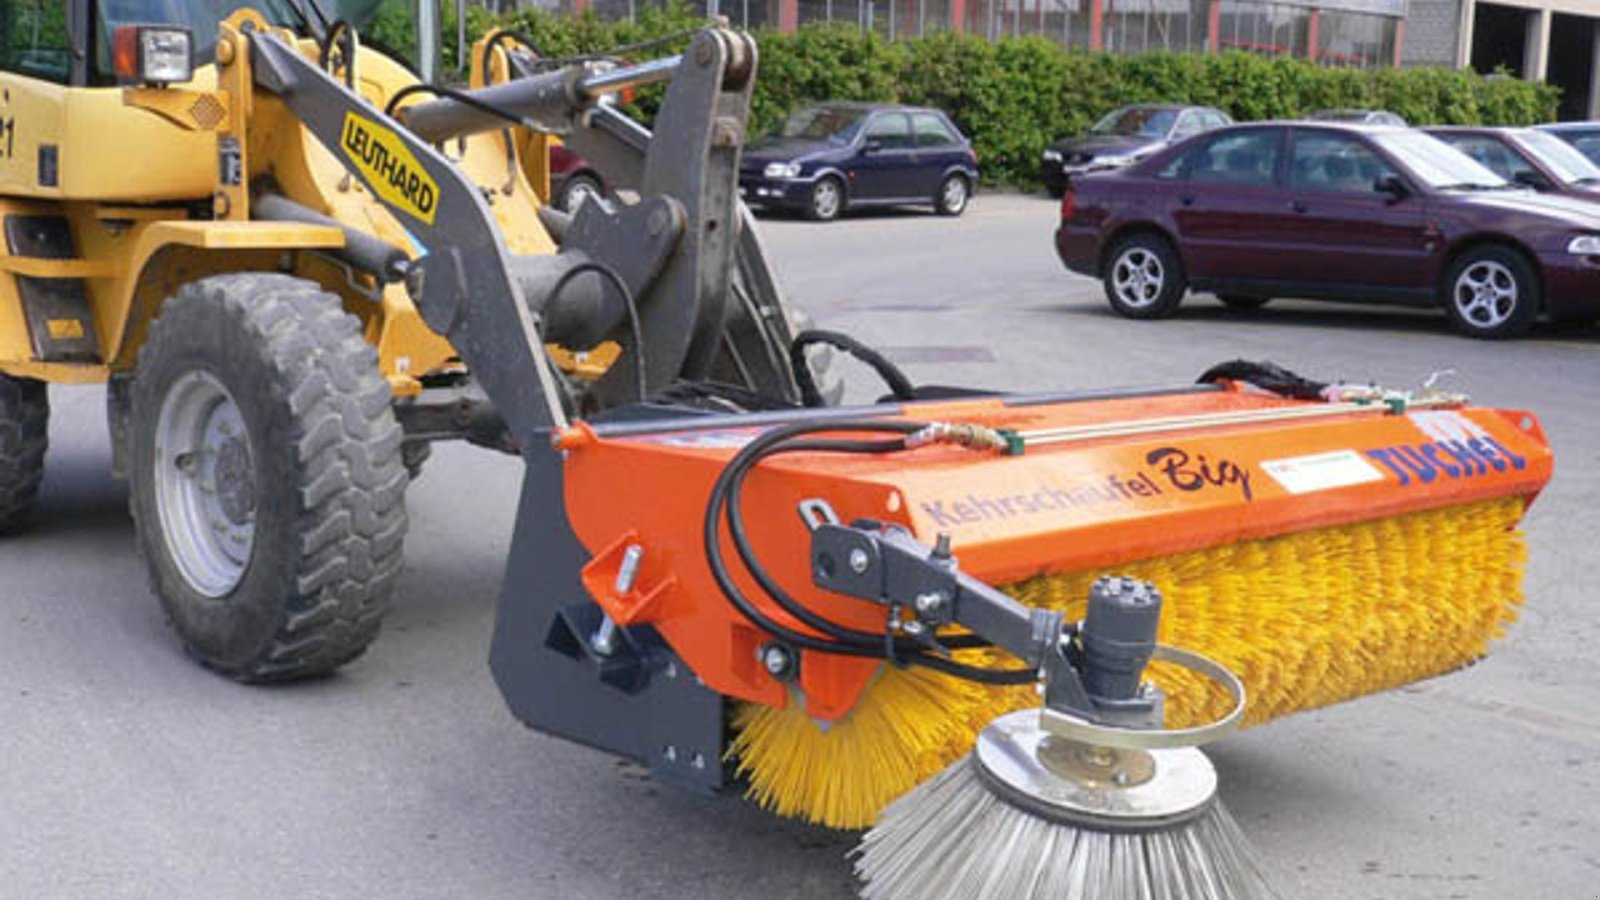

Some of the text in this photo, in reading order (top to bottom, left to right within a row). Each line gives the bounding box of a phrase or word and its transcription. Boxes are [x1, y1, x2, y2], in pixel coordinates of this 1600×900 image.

[346, 118, 434, 214] LEUTHARD
[921, 447, 1252, 527] Kehrschaufel Big
